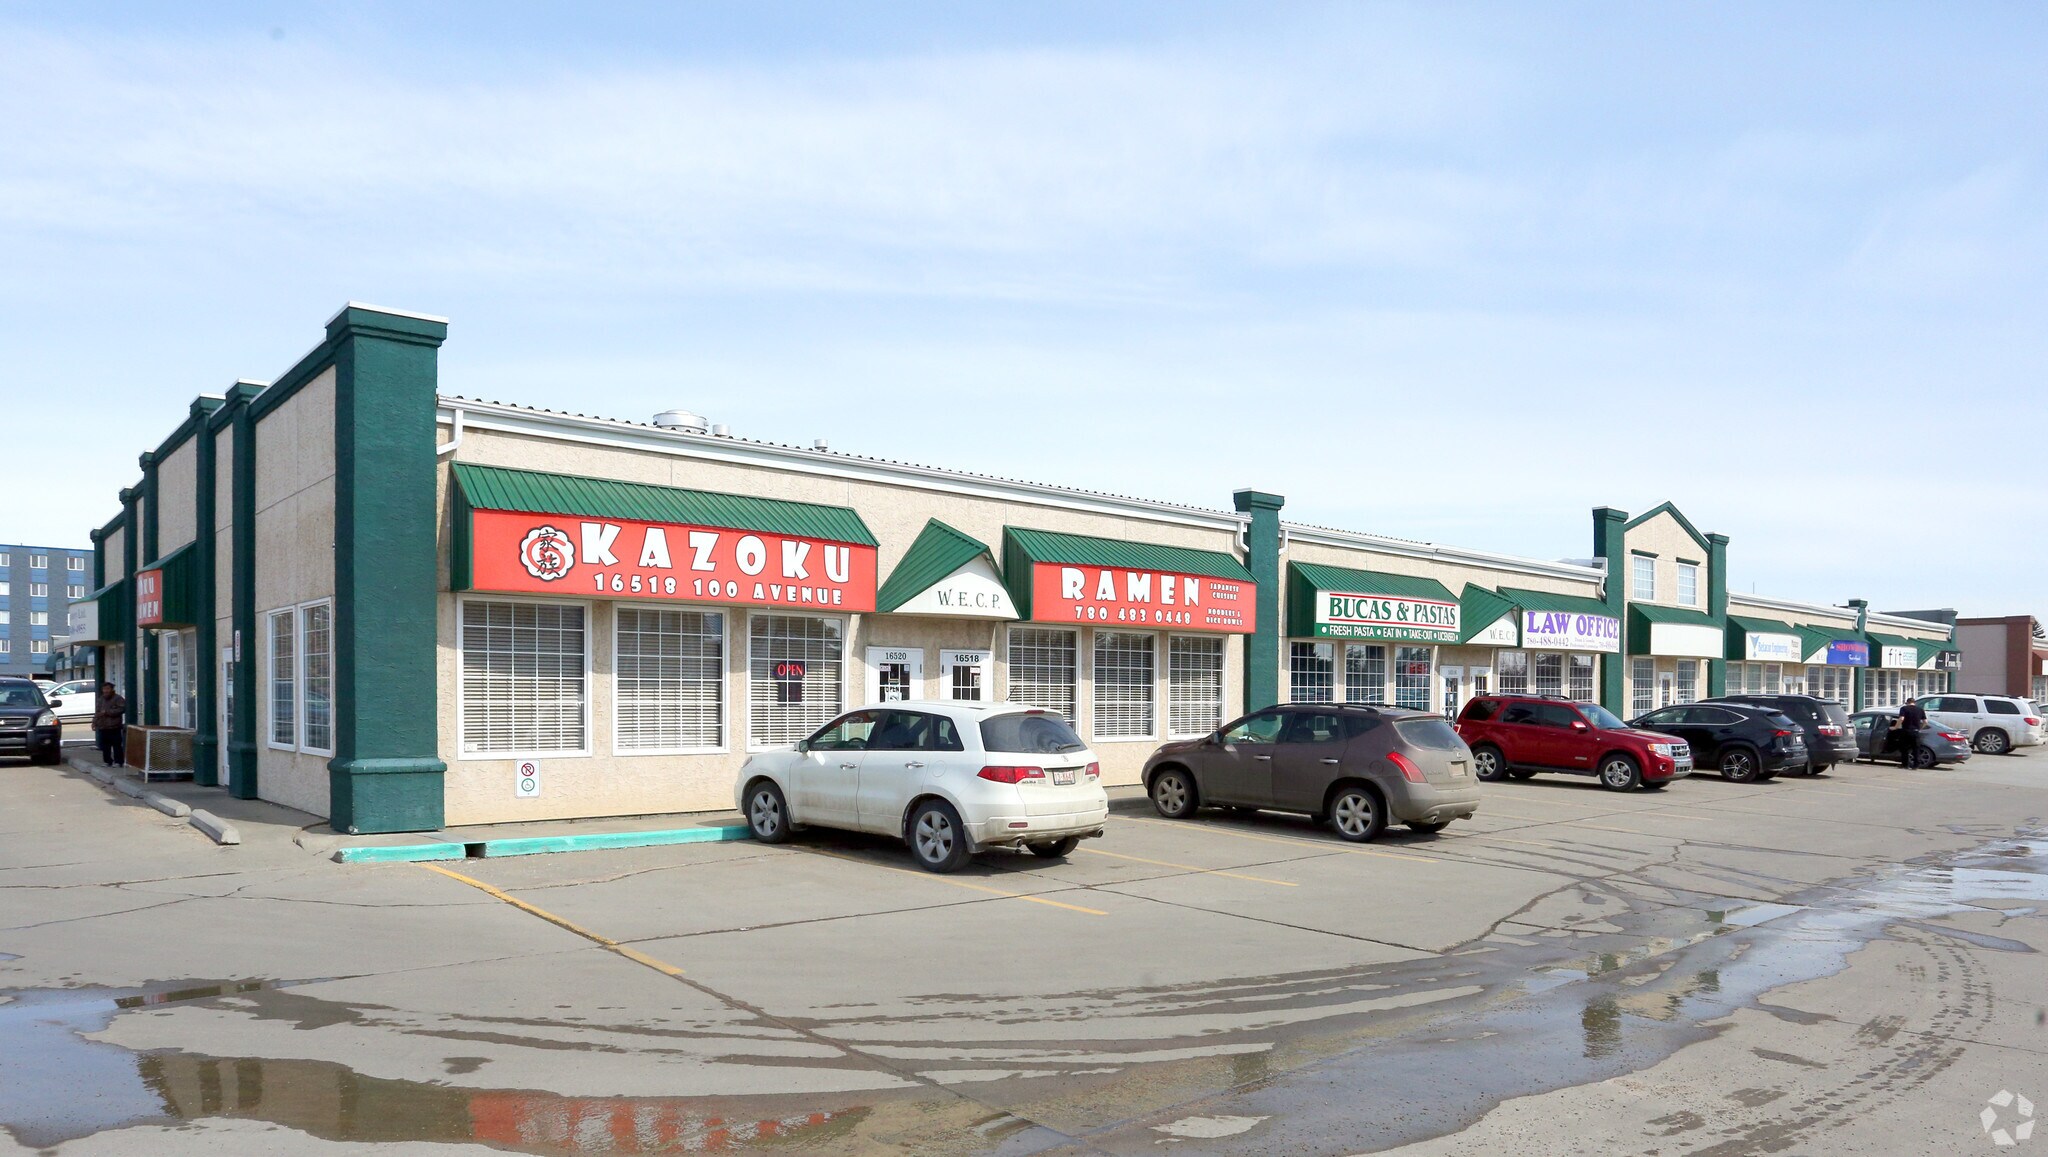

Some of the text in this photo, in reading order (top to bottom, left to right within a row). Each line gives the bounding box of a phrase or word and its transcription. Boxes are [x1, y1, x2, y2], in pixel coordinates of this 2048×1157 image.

[579, 521, 850, 583] KAZOKU
[593, 572, 843, 606] 16518 100 AVENUE
[1061, 567, 1200, 607] RAMEN
[1210, 582, 1239, 593] JAPANESE
[1212, 591, 1237, 600] CUISINE
[1074, 605, 1191, 624] 780 483 0448
[1329, 597, 1456, 626] BUCAS & PASTAS
[1329, 625, 1352, 636] FRESH
[1353, 627, 1375, 637] PASTA
[1382, 629, 1394, 638] EAT
[1395, 631, 1402, 639] IN
[1408, 629, 1433, 640] TAKE-OUT
[1526, 611, 1619, 640] LAW OFFICE
[1526, 637, 1569, 647] 780-488-0442
[885, 652, 907, 660] 16520
[954, 654, 980, 663] 16518
[777, 663, 803, 676] OPEN
